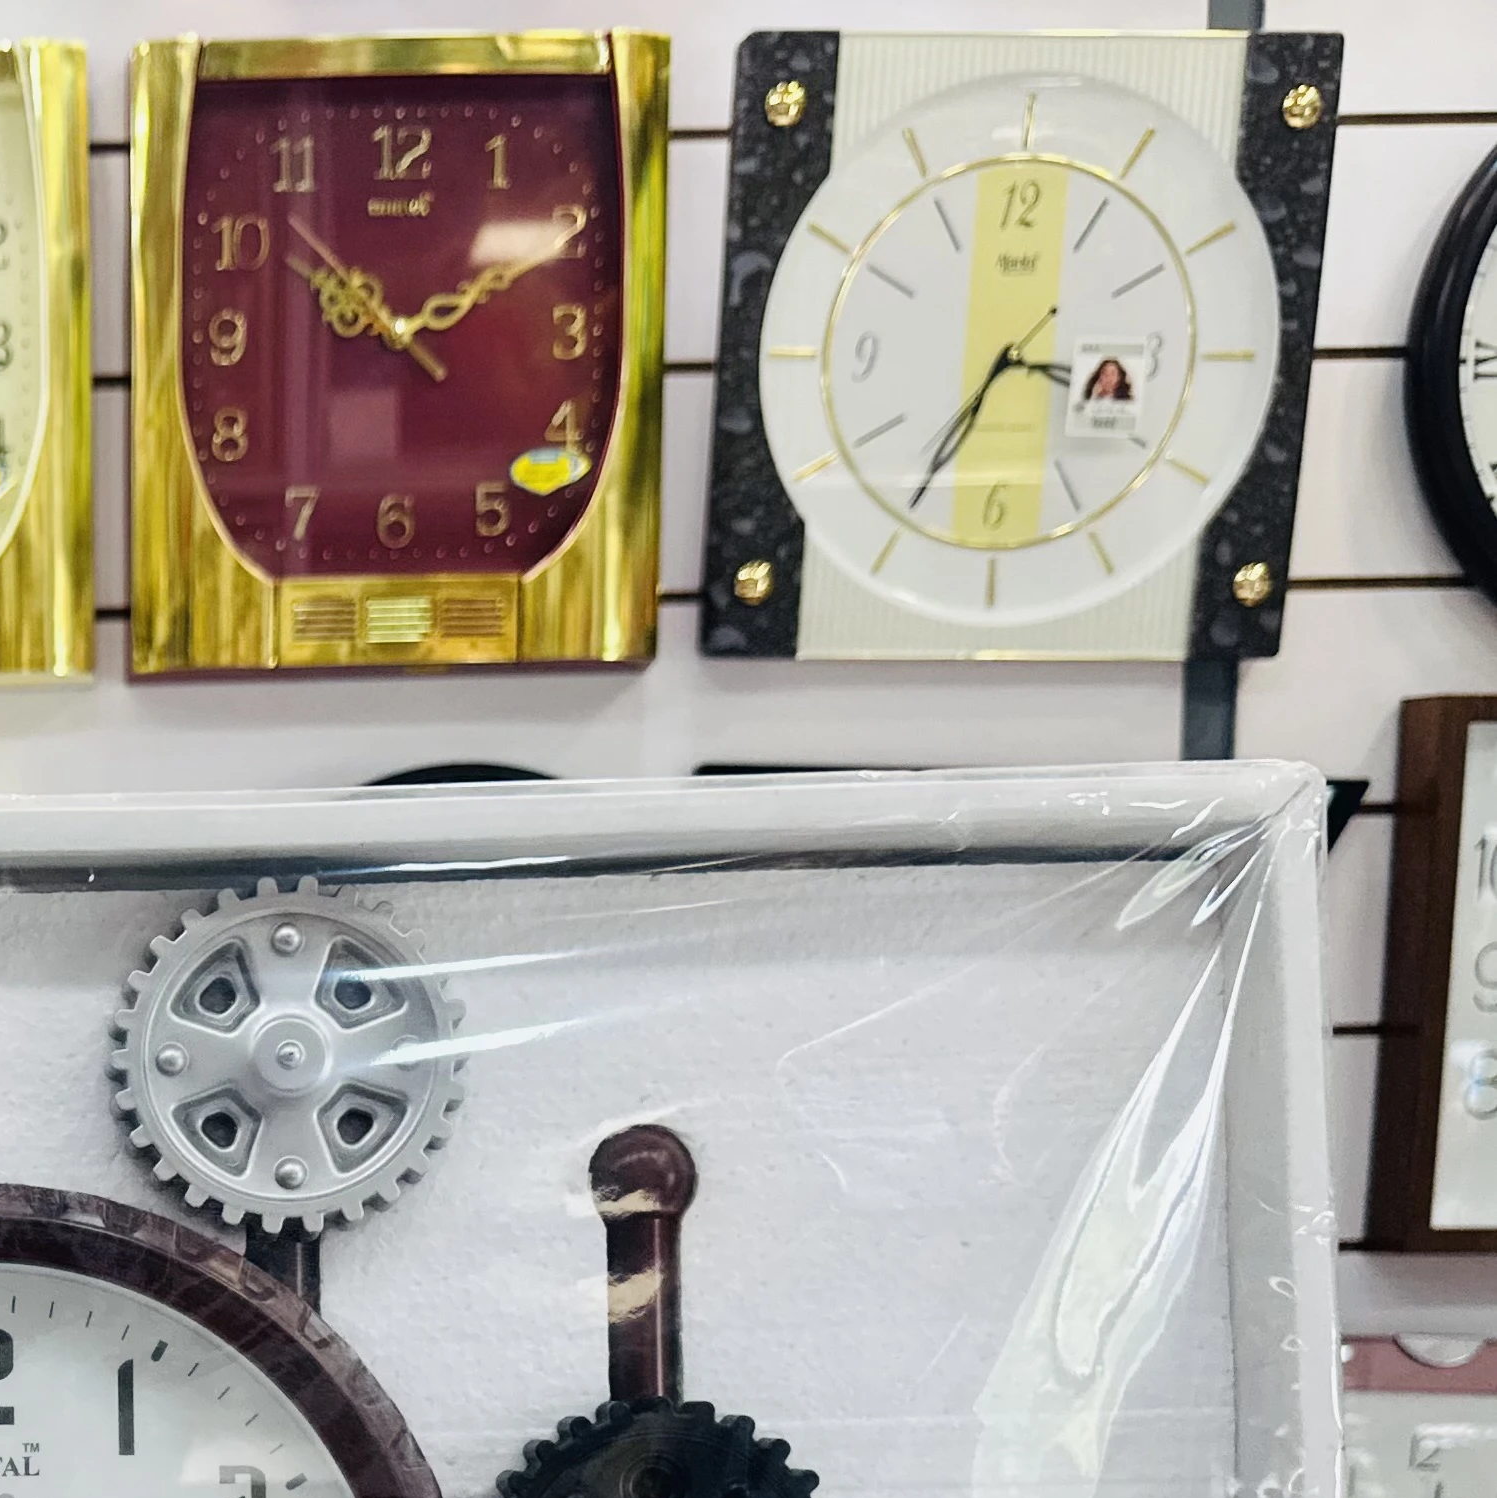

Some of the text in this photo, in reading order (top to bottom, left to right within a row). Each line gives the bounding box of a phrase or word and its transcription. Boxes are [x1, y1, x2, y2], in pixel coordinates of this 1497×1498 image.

[269, 134, 316, 193] 11
[371, 125, 433, 181] 12
[484, 134, 511, 190] 1
[551, 204, 588, 259] 2
[1000, 180, 1040, 228] 12
[210, 214, 270, 271] 10
[208, 306, 248, 367] 9
[552, 303, 588, 361] 3
[852, 332, 880, 382] 9
[212, 407, 249, 463] 8
[544, 400, 584, 454] 4
[285, 485, 323, 540] 7
[377, 494, 415, 549] 6
[474, 482, 512, 537] 5
[982, 480, 1009, 528] 6
[118, 1359, 135, 1456] 1
